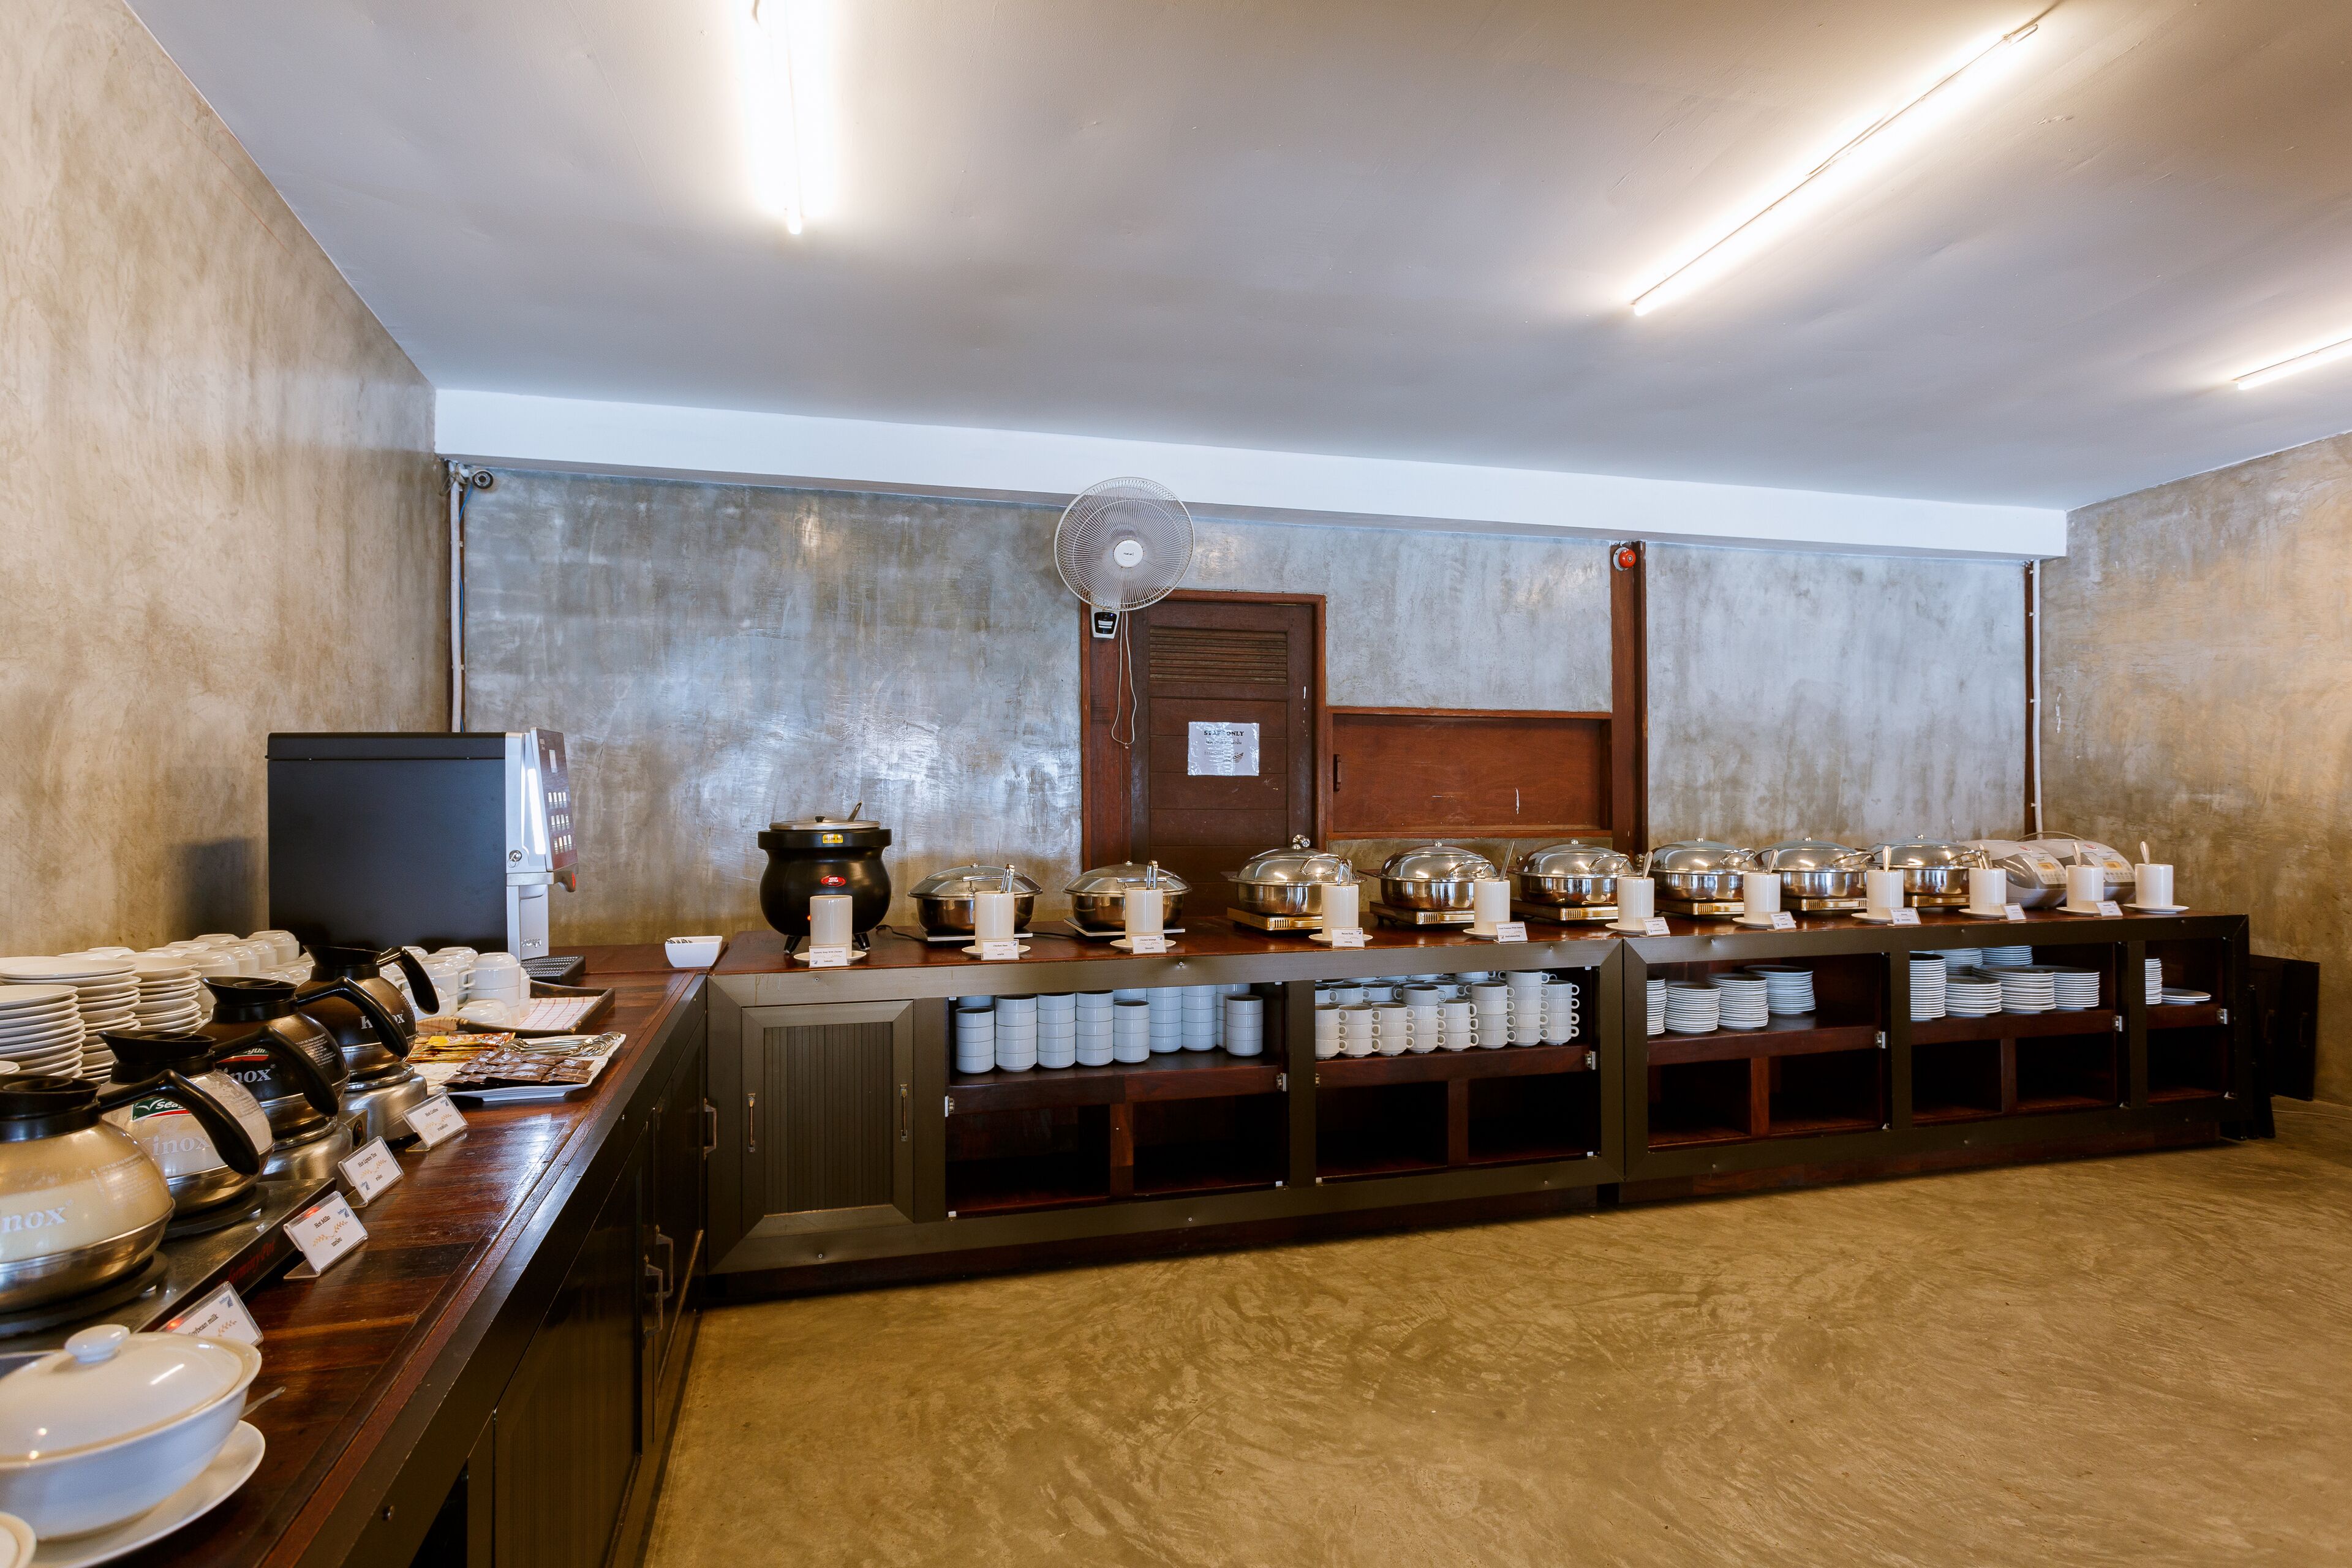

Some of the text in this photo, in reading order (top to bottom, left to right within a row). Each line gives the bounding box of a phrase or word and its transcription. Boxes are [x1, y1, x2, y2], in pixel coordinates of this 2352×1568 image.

[223, 1068, 272, 1083] nox
[141, 1135, 211, 1156] inox
[208, 1313, 219, 1326] milk
